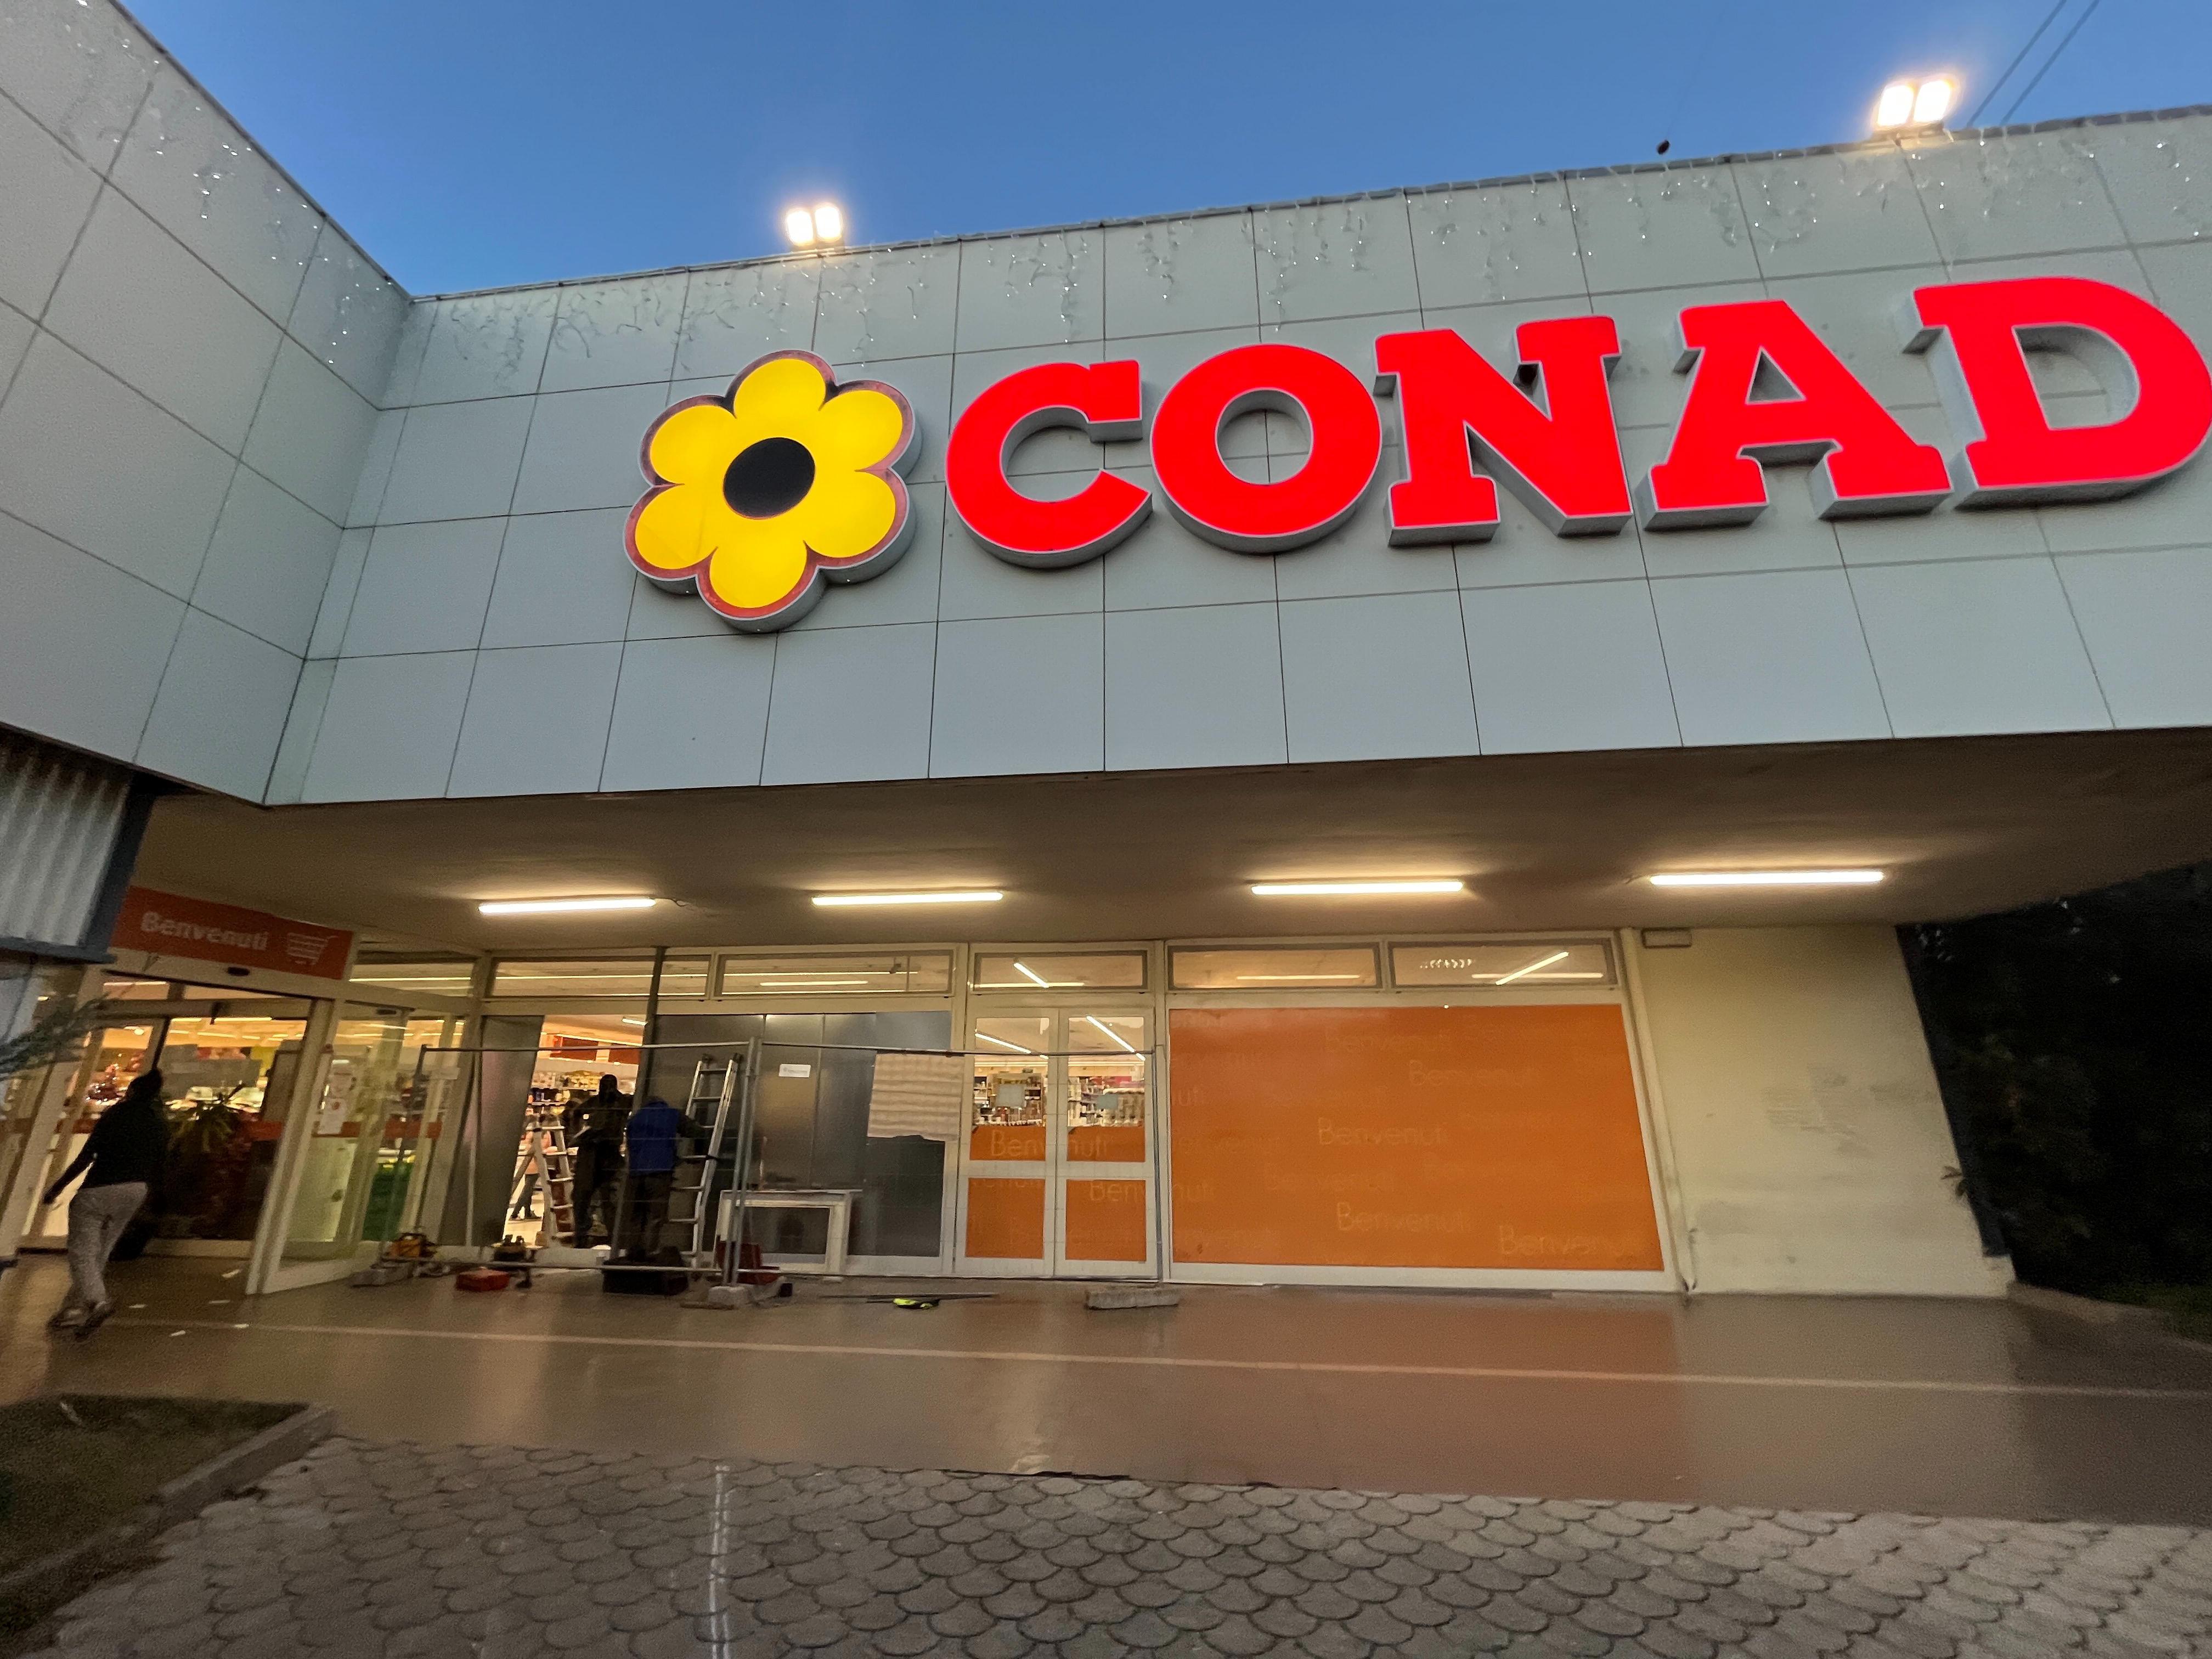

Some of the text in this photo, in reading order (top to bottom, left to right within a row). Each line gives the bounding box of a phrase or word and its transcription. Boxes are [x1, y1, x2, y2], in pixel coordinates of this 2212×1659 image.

[945, 276, 2212, 554] CONAD
[140, 911, 269, 951] Benvenuti
[1318, 1117, 1450, 1146] Benvenuti
[1336, 1201, 1472, 1232] Benvenuti
